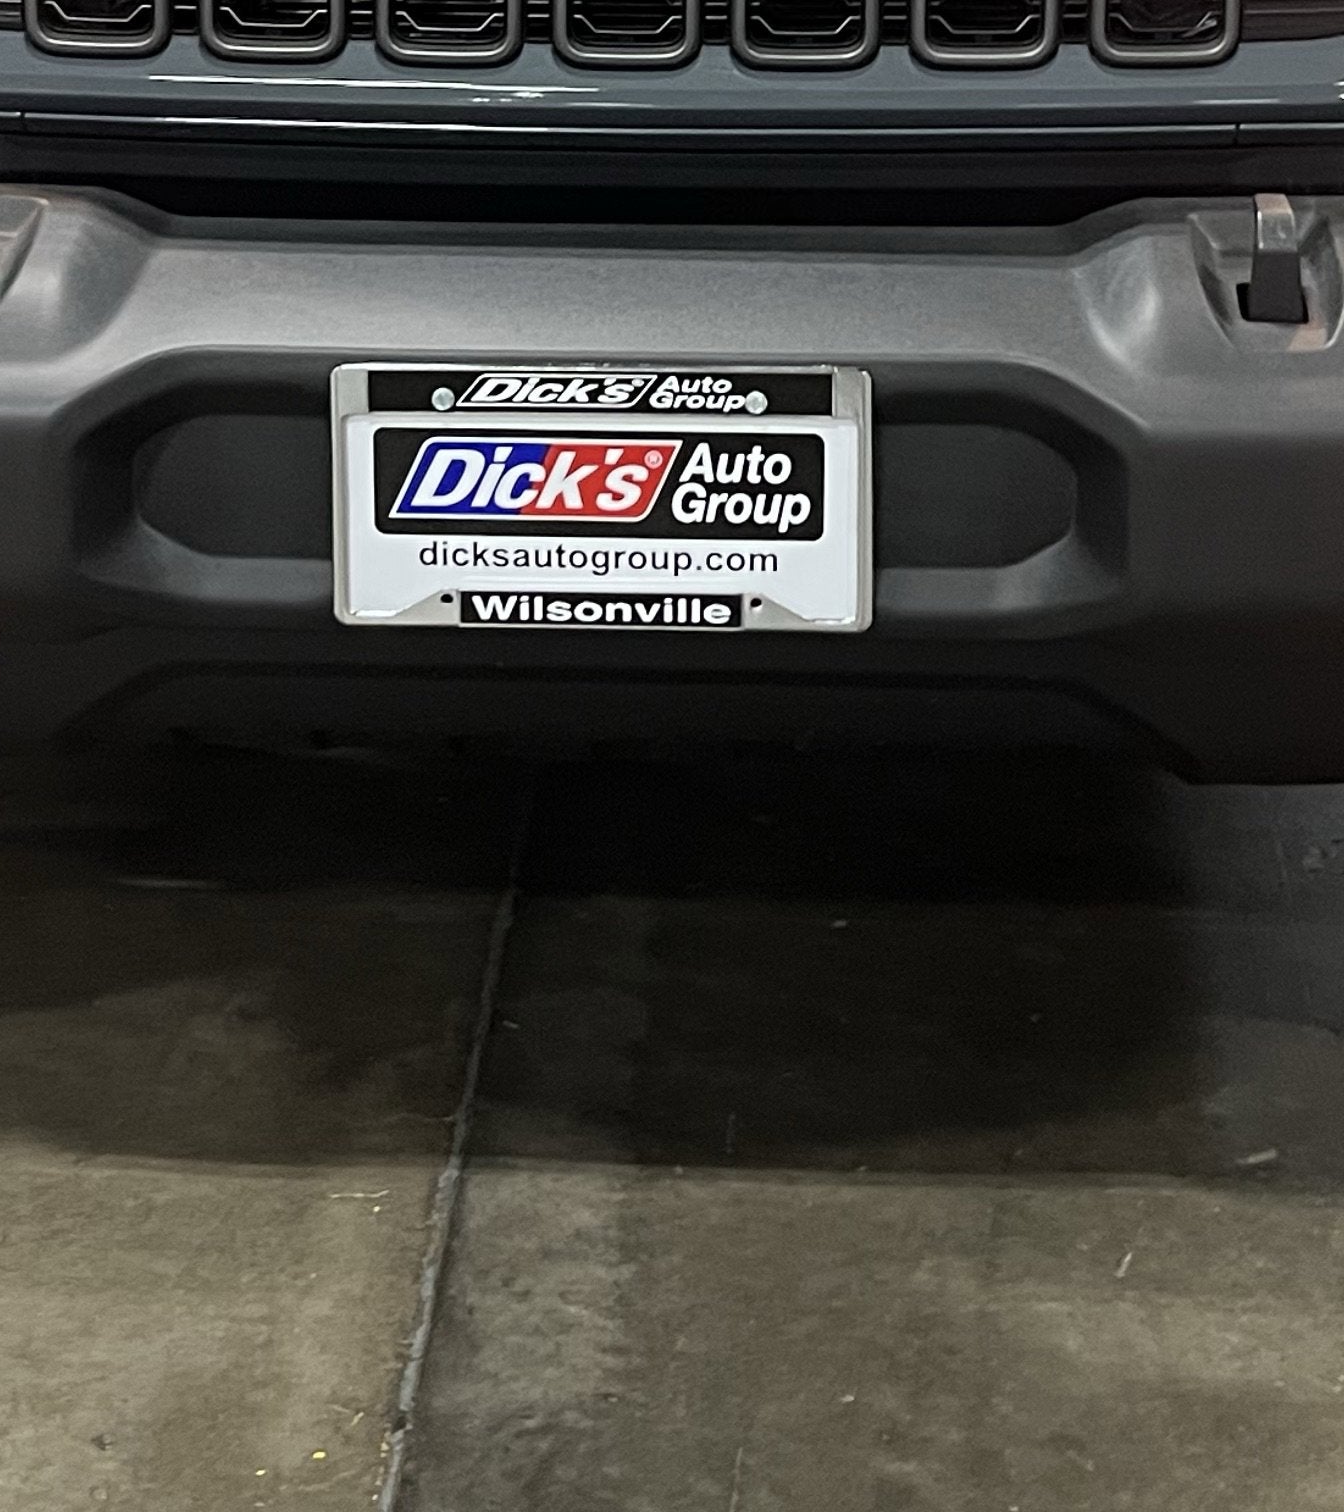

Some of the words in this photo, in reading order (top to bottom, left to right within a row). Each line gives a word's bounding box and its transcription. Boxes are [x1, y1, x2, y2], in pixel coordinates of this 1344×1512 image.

[470, 376, 635, 404] Dick's
[656, 375, 733, 394] Auto
[649, 393, 746, 413] Group
[410, 445, 650, 512] Dick's
[679, 442, 793, 485] Auto
[671, 482, 811, 533] Group
[419, 540, 779, 577] dicksautogroup.com
[471, 594, 732, 625] Wilsonville
